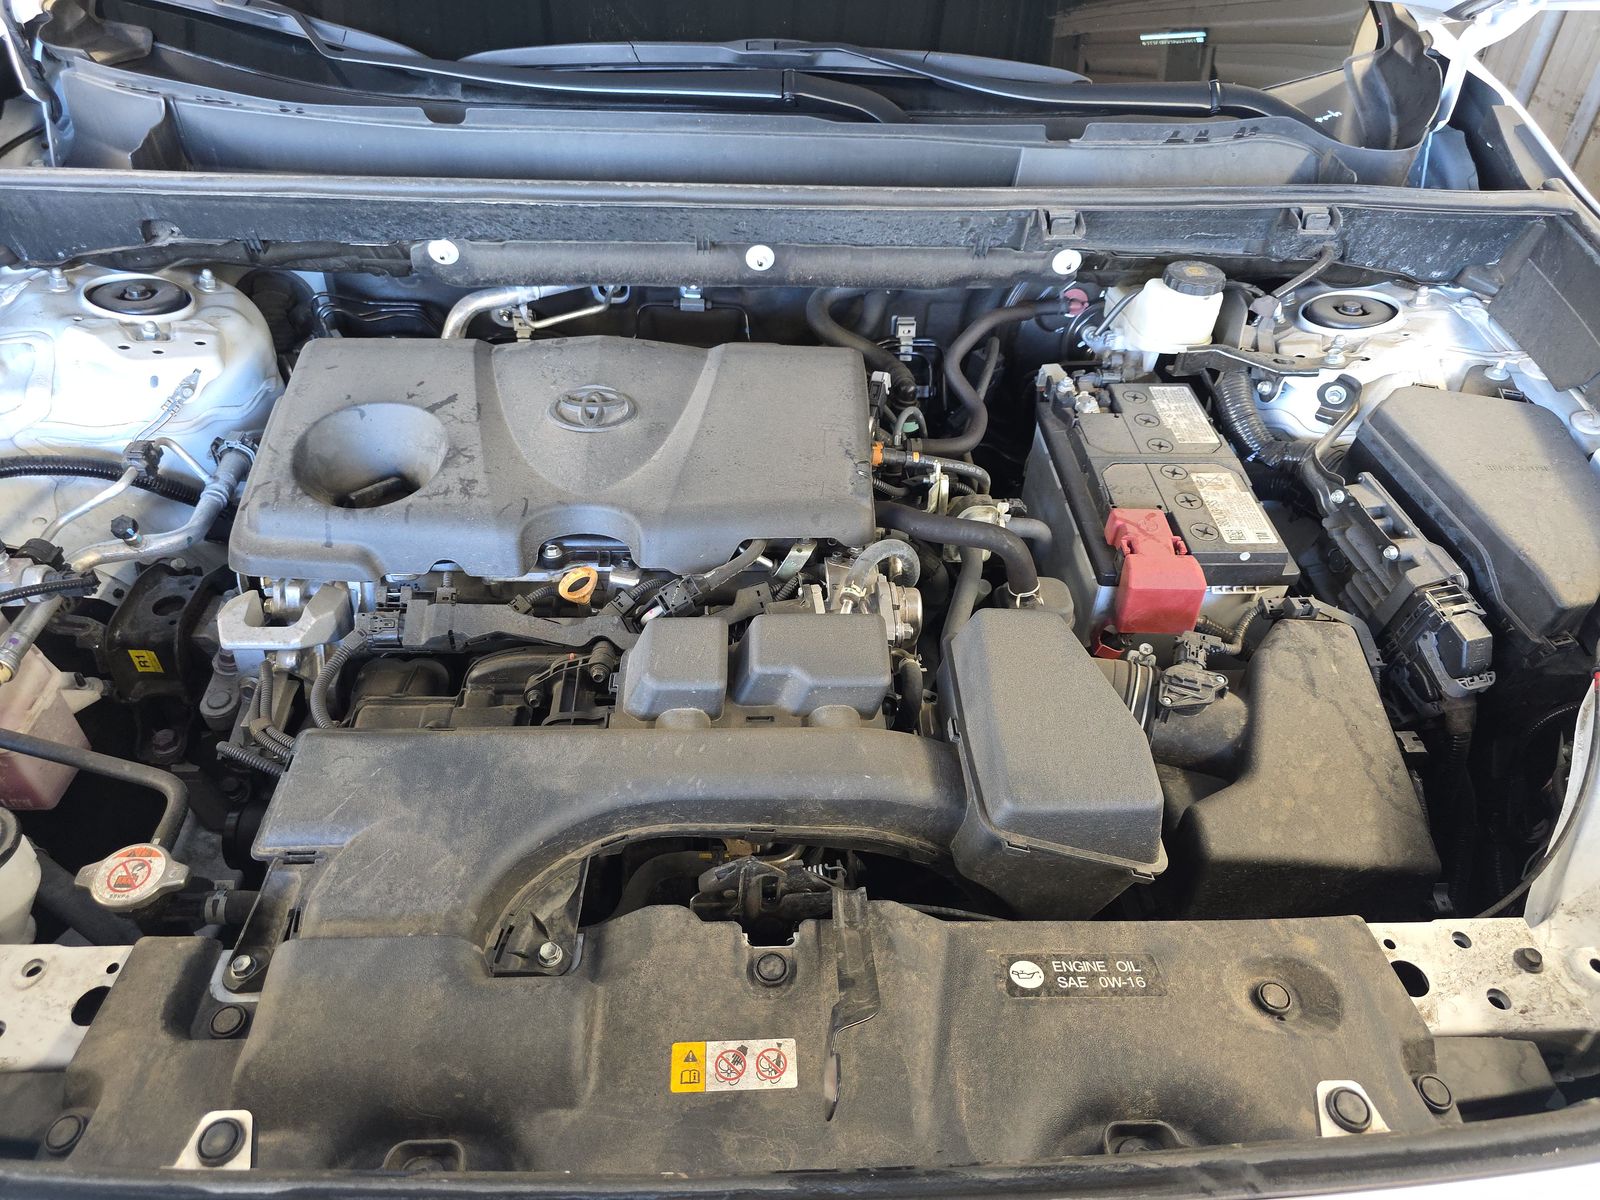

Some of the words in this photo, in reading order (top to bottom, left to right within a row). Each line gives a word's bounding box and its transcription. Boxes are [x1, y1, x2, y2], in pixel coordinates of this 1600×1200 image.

[135, 655, 150, 668] R1
[1051, 960, 1107, 972] ENGINE
[1116, 960, 1142, 972] OIL
[1058, 976, 1089, 988] SAE
[1098, 976, 1147, 988] 0W-16
